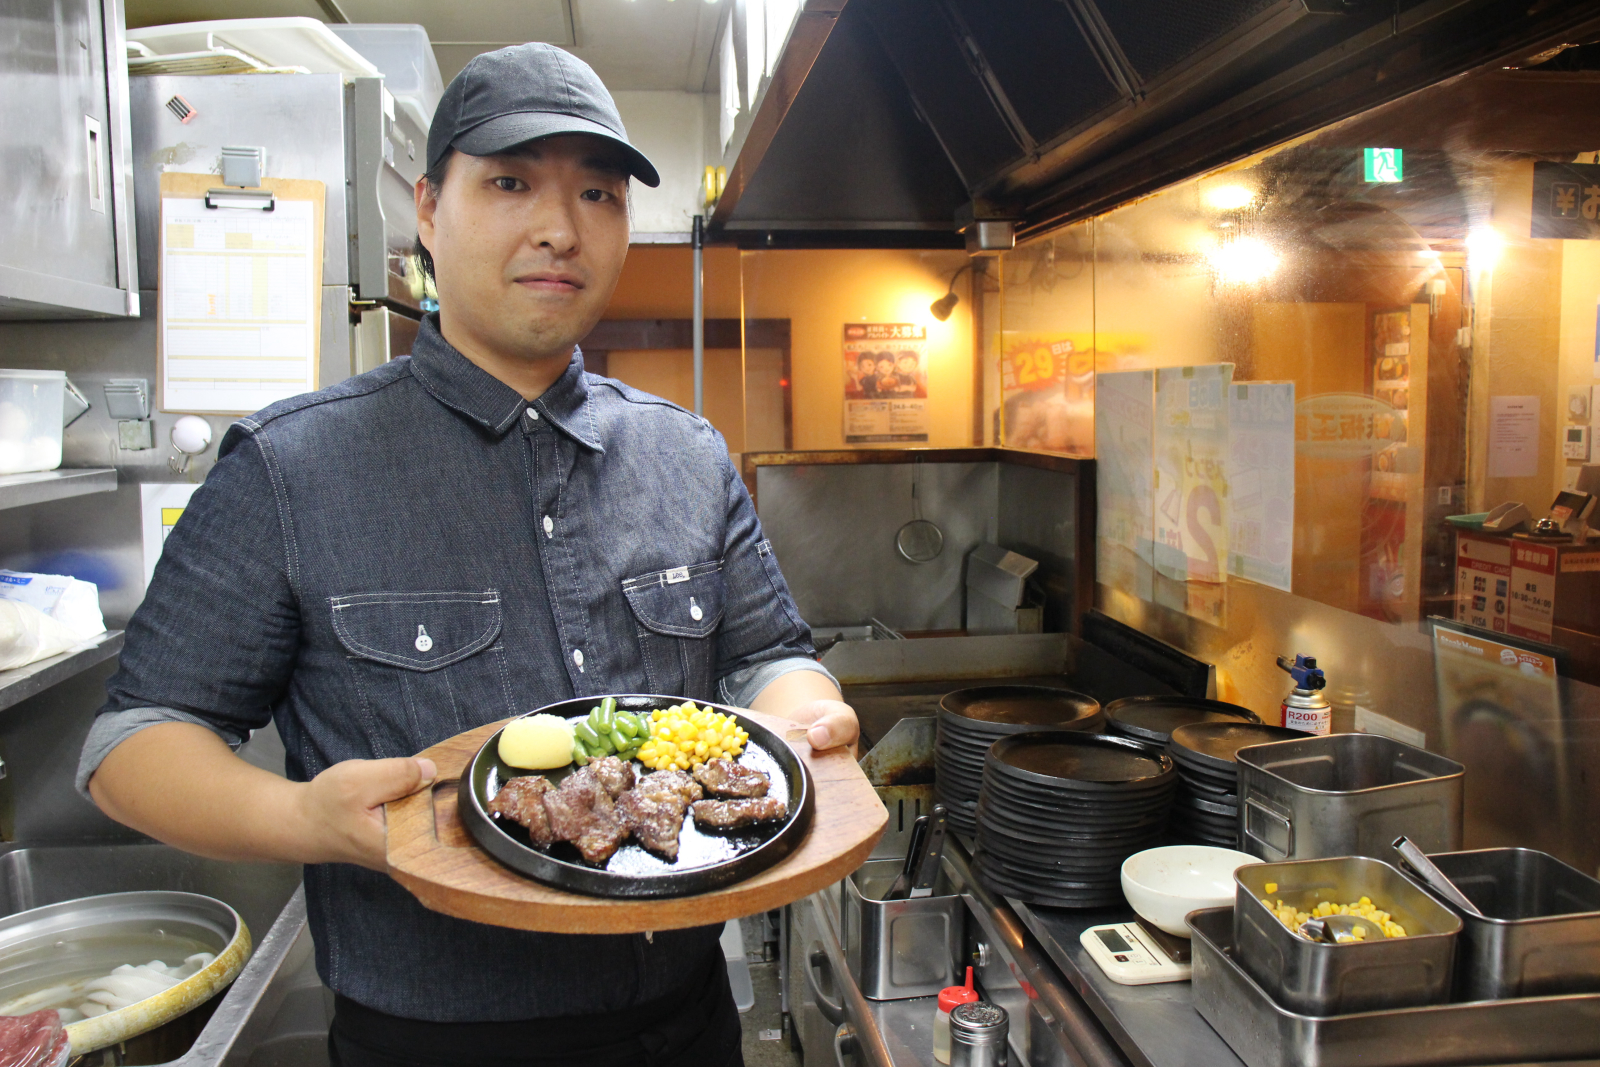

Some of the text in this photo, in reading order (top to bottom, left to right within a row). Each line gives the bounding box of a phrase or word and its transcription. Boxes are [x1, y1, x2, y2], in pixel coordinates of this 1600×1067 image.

[1015, 347, 1054, 385] 29
[1471, 561, 1492, 571] CREDIT
[1471, 616, 1487, 627] VISA
[1288, 710, 1318, 721] R200
